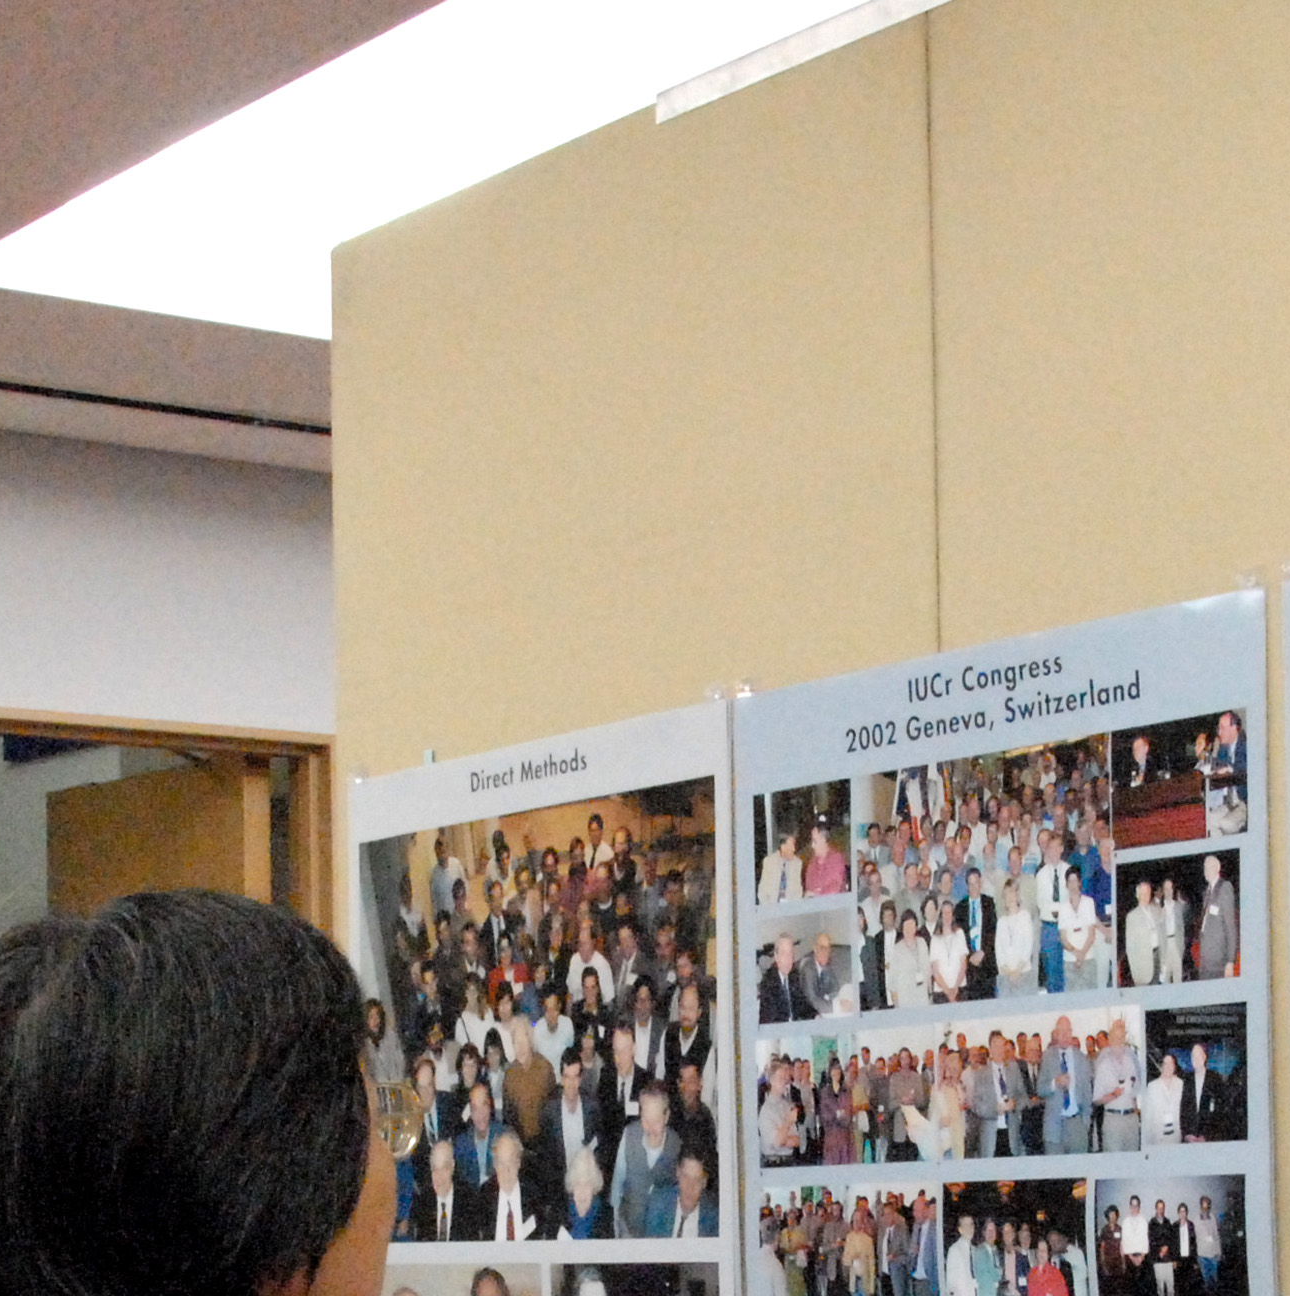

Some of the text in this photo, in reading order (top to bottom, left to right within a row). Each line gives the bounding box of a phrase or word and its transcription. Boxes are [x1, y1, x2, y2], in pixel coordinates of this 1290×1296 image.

[907, 652, 1064, 705] IUCr Congress
[845, 670, 1143, 755] 2002 Geneva, Switzerland
[468, 750, 589, 794] Direct Methods
